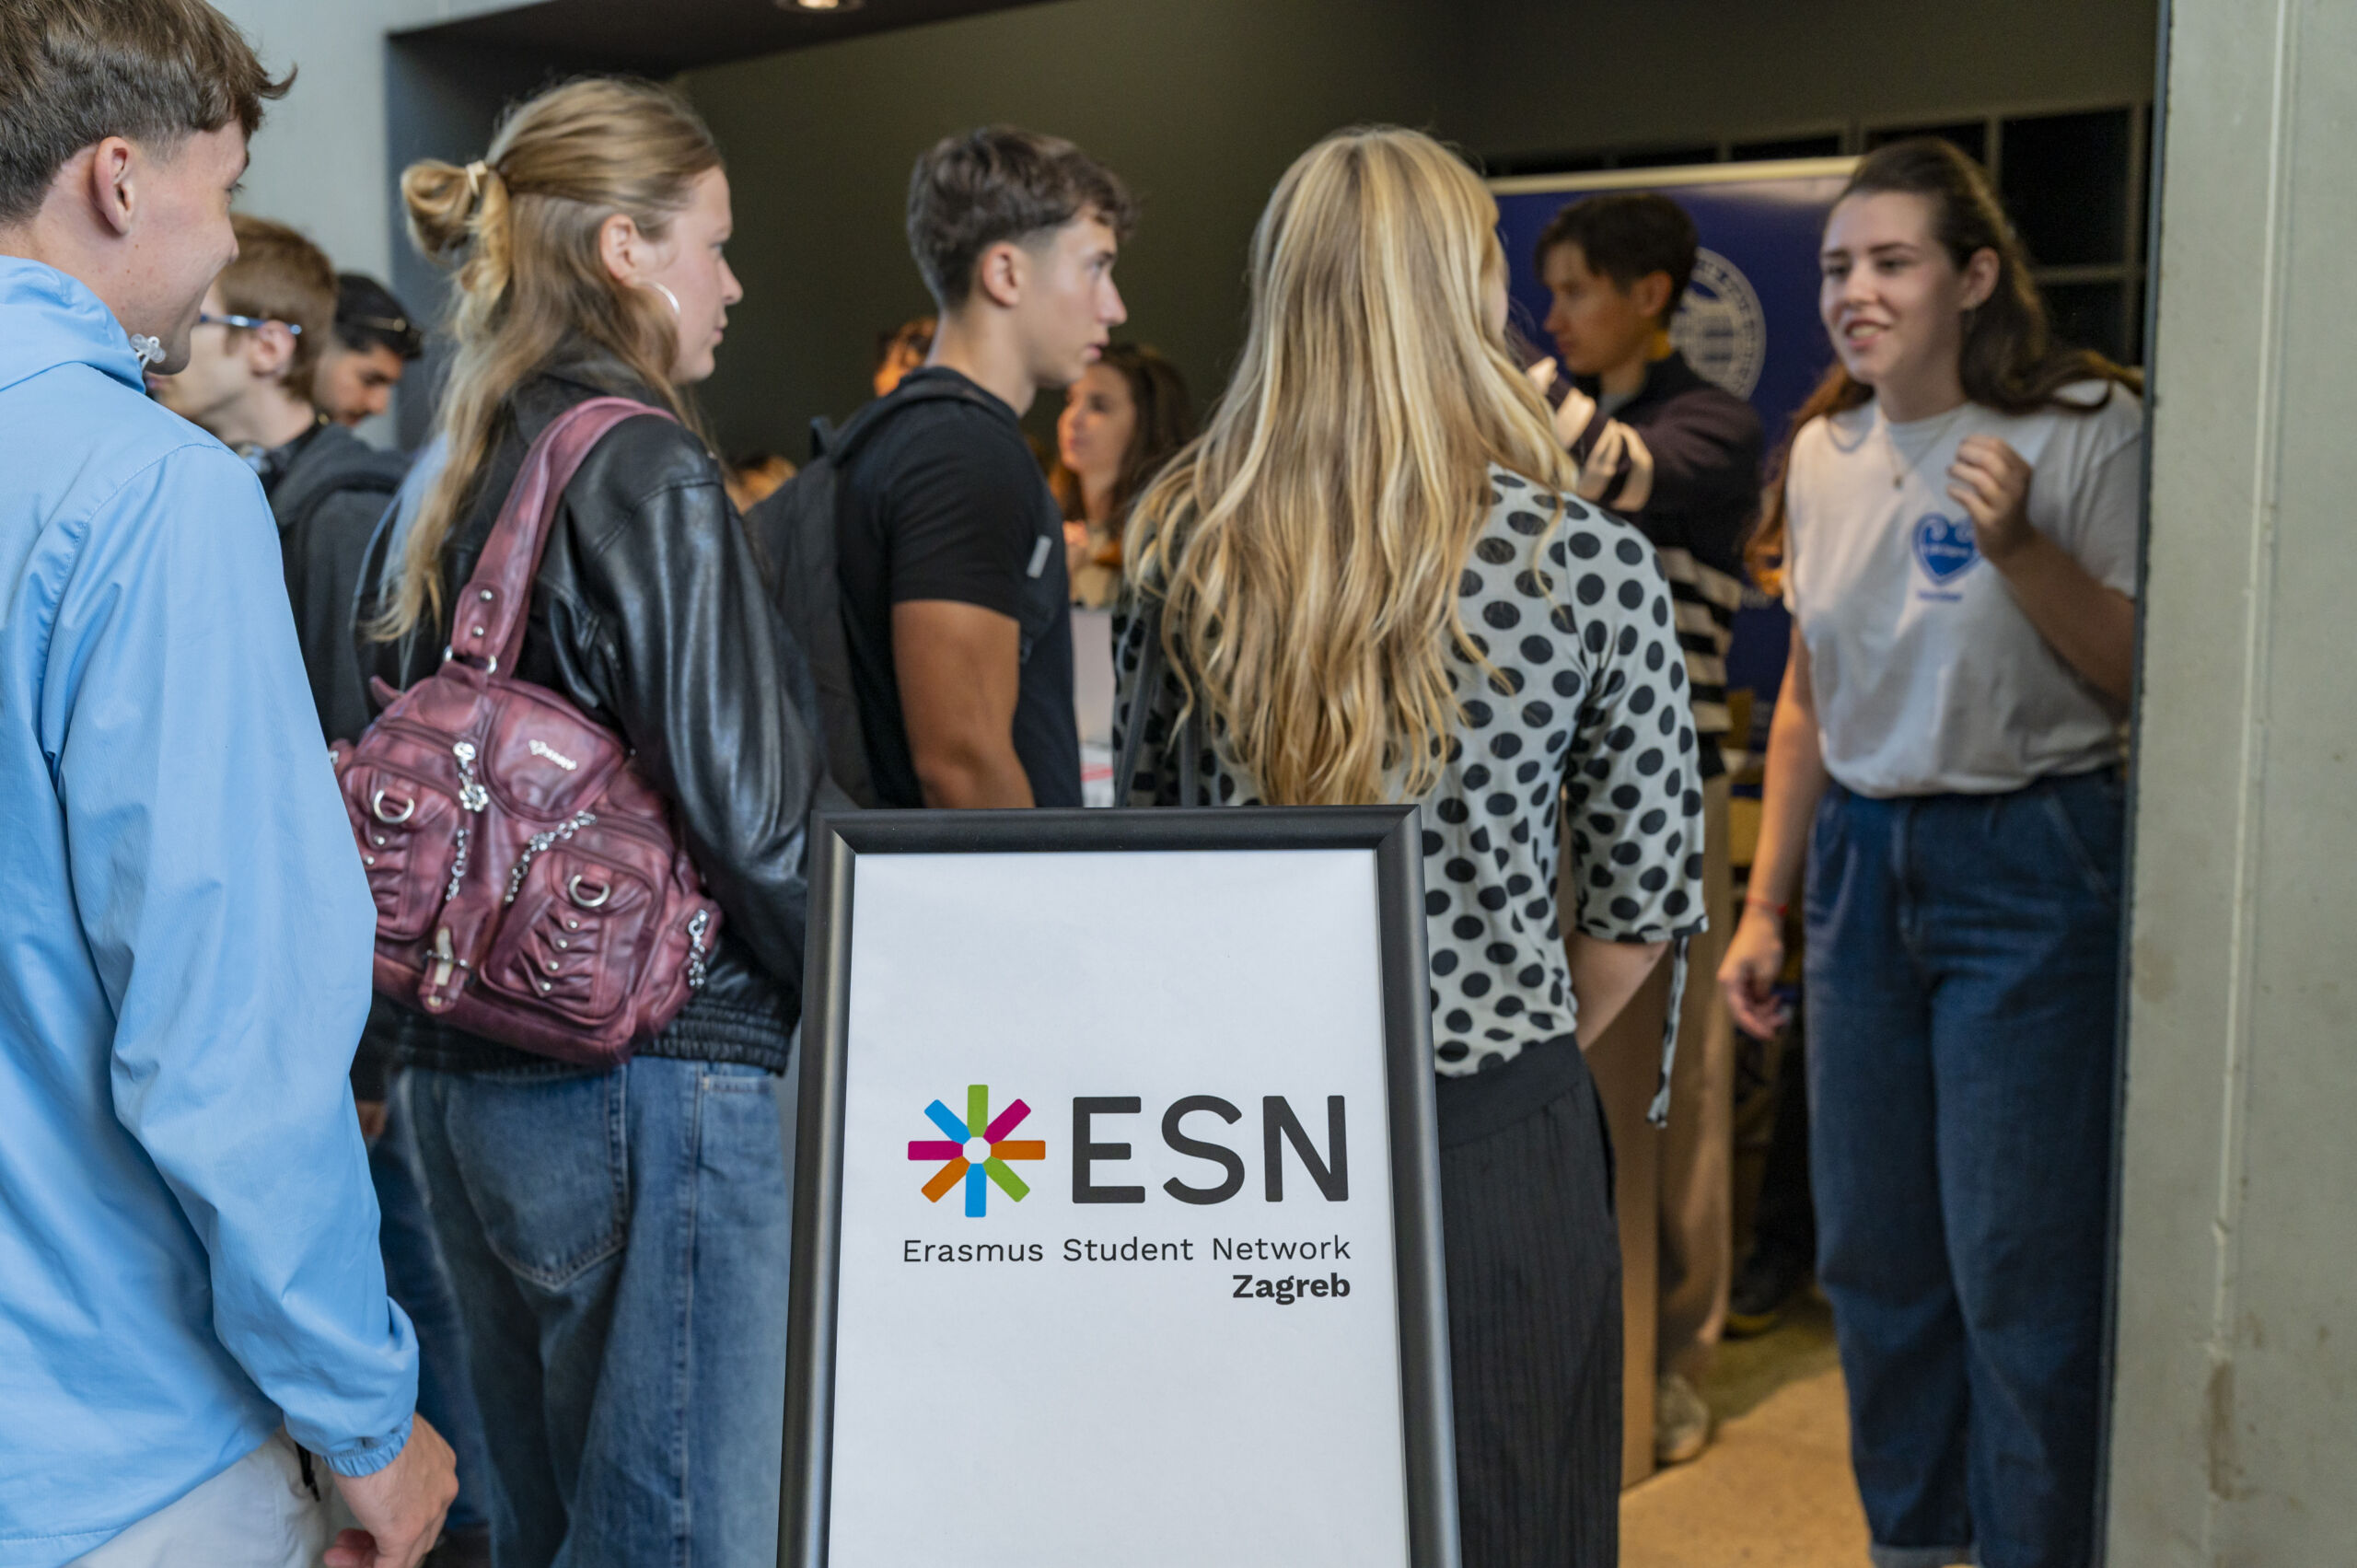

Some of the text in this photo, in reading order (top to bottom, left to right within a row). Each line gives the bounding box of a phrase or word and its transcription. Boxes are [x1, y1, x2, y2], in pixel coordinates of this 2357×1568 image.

[1072, 1095, 1349, 1205] ESN
[903, 1234, 1351, 1262] Erasmus Student Network
[1232, 1272, 1351, 1306] Zagreb
